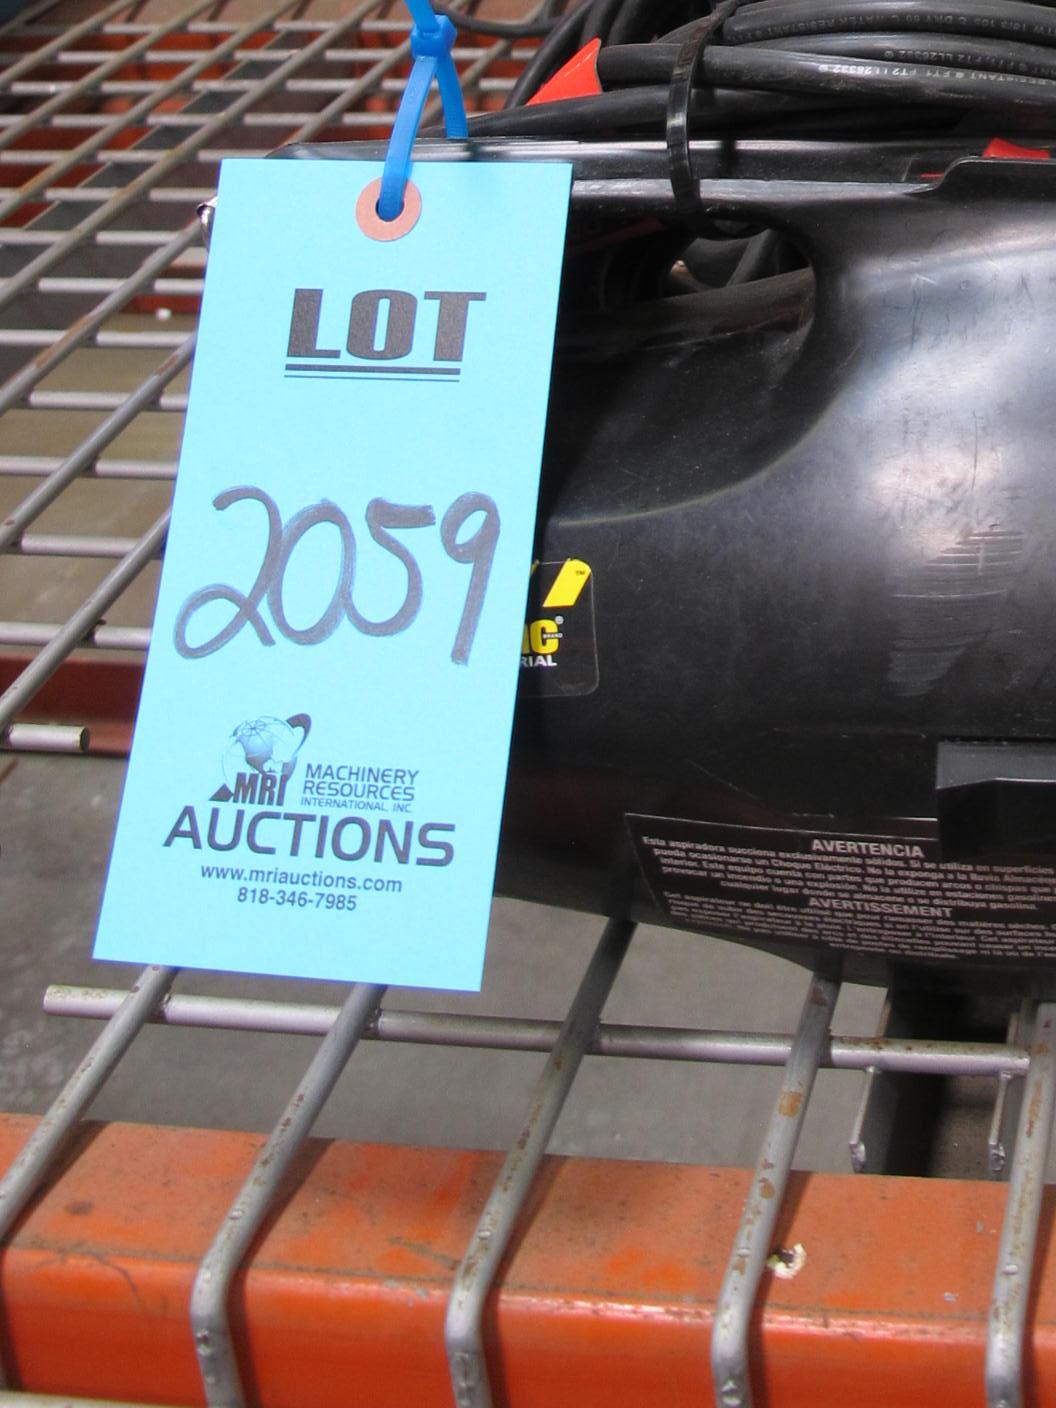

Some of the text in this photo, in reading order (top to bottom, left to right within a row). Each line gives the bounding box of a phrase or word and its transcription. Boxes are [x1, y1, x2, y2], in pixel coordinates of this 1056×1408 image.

[286, 288, 486, 361] LOT
[174, 485, 501, 666] 2059
[232, 764, 287, 806] MRI
[304, 763, 420, 786] MACHINERY
[302, 780, 415, 802] RESOURCES
[162, 805, 457, 868] AUCTIONS
[811, 839, 925, 858] AVERTENCIA
[642, 836, 666, 846] Esta
[669, 841, 725, 852] aspiradora
[778, 851, 863, 864] exclusivamente
[992, 865, 1054, 874] superficies
[771, 859, 812, 870] Choque
[200, 865, 402, 892] www.mriauctions.com
[237, 887, 357, 911] 818-346-7985
[809, 897, 952, 917] AVERTISSEMENT
